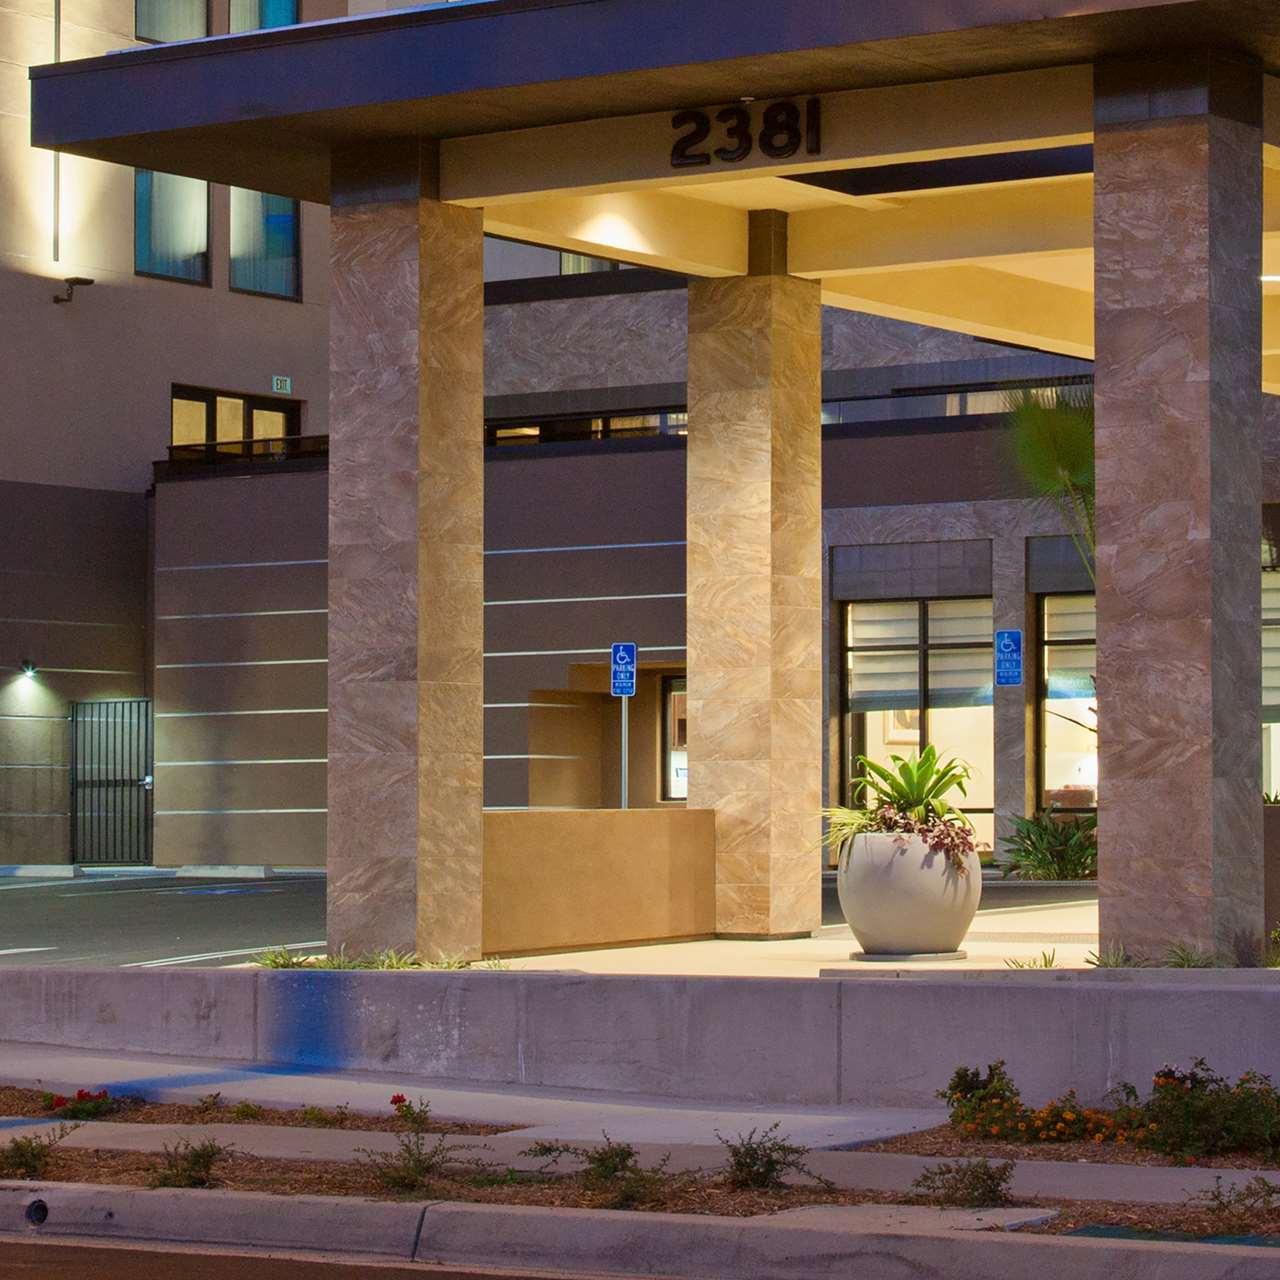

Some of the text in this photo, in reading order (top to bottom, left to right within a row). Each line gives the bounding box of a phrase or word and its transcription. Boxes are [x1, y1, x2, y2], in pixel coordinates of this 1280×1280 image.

[671, 96, 821, 169] 2381
[276, 377, 288, 391] EXIT
[613, 664, 634, 672] PARKING
